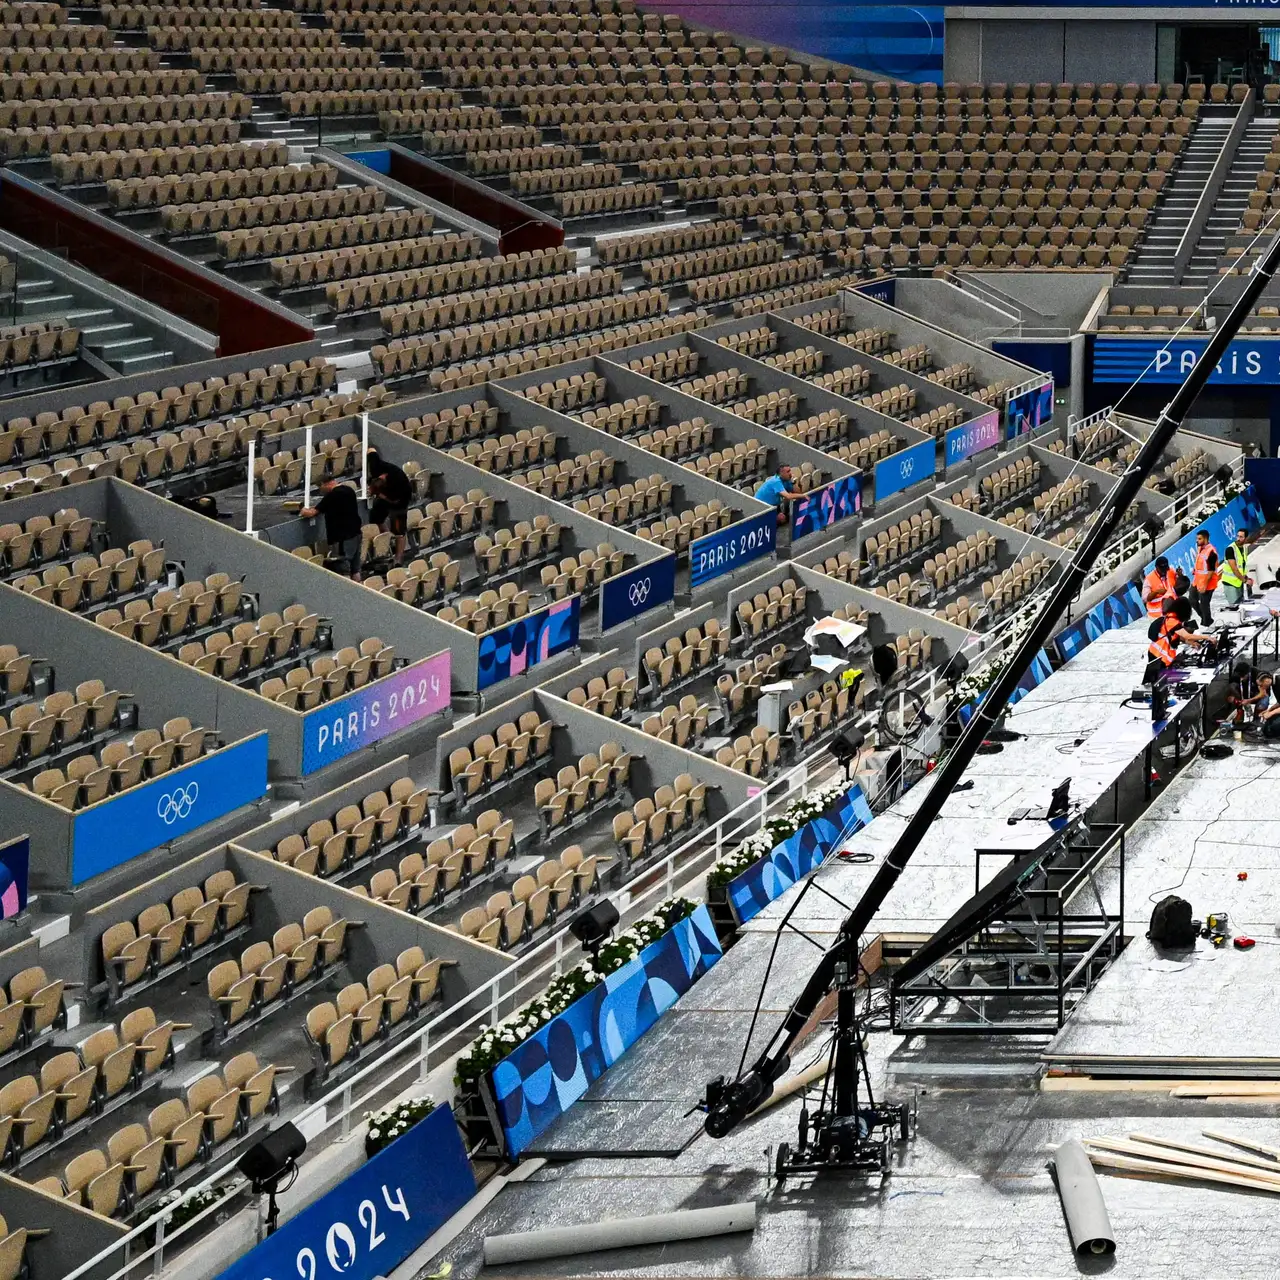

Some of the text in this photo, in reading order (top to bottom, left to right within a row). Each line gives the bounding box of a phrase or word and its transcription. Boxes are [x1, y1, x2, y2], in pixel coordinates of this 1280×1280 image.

[1155, 350, 1261, 375] PAIS
[951, 423, 995, 456] PARIS 2024
[700, 525, 771, 574] PARIS 2024
[318, 674, 441, 753] PARIS 2024
[296, 1184, 411, 1280] 2024
